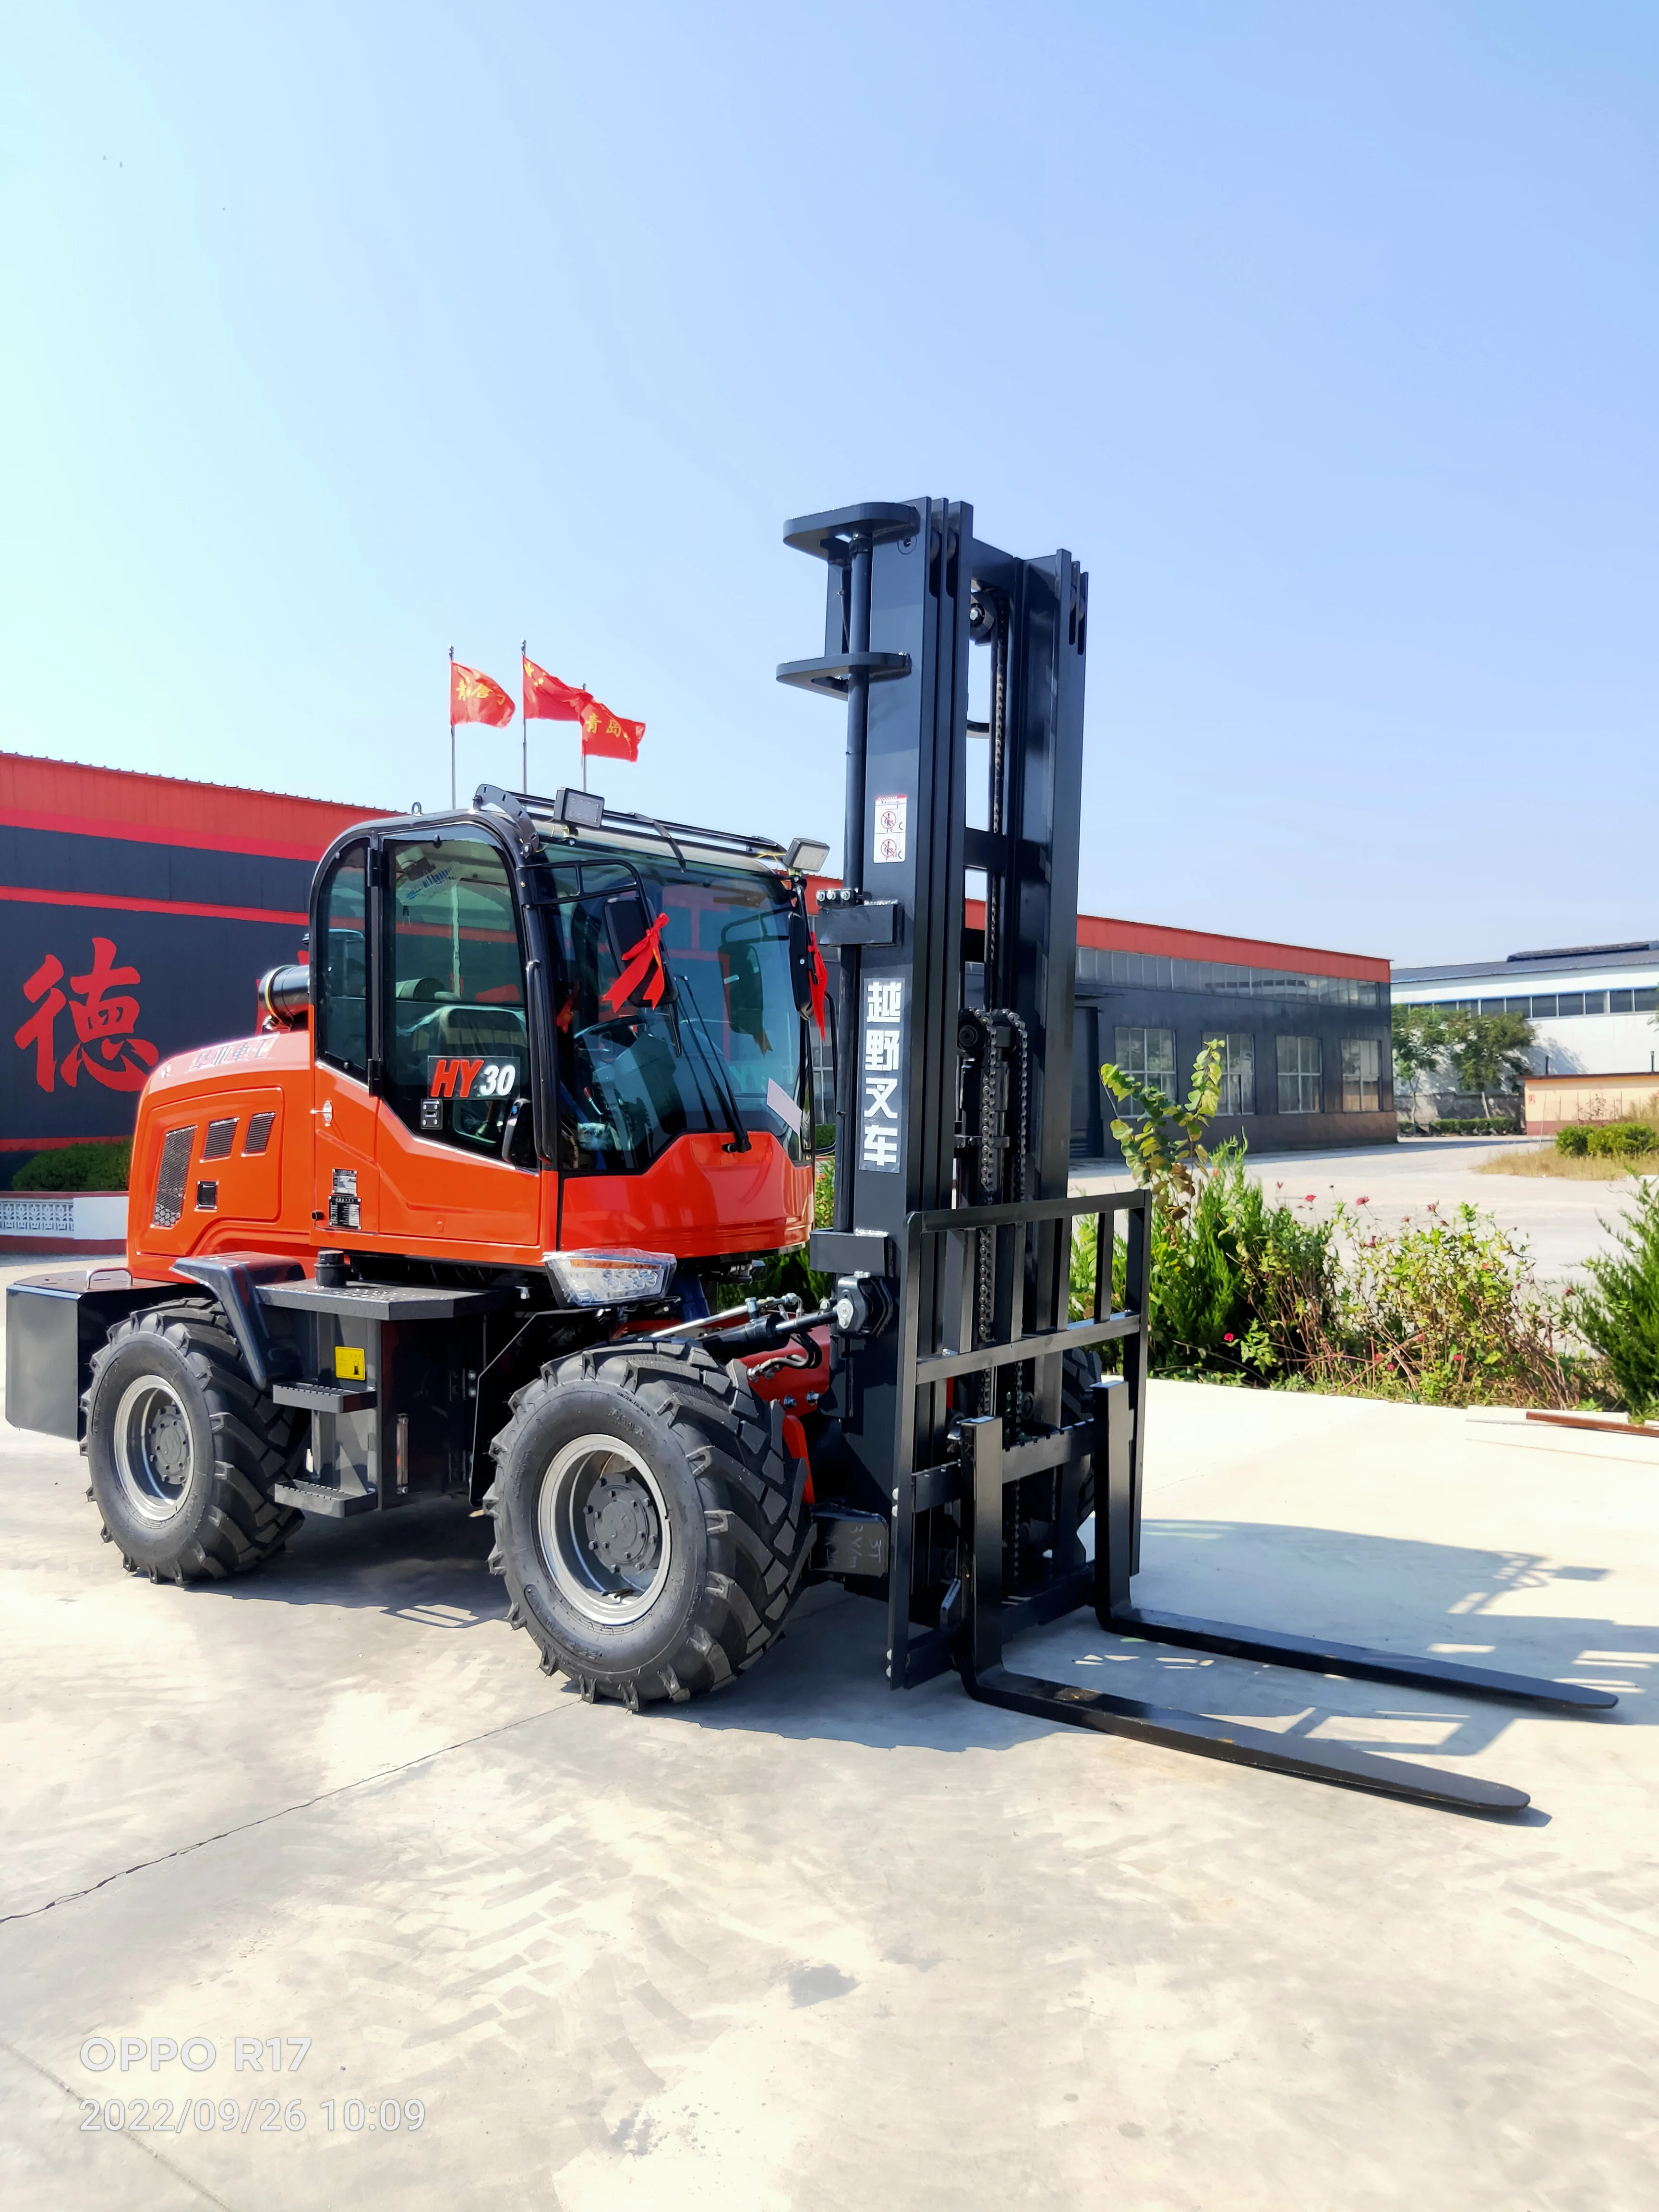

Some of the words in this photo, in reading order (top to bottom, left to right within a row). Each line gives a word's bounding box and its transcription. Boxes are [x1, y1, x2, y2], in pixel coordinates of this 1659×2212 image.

[14, 937, 159, 1093] 德
[864, 982, 901, 1166] 越野叉车
